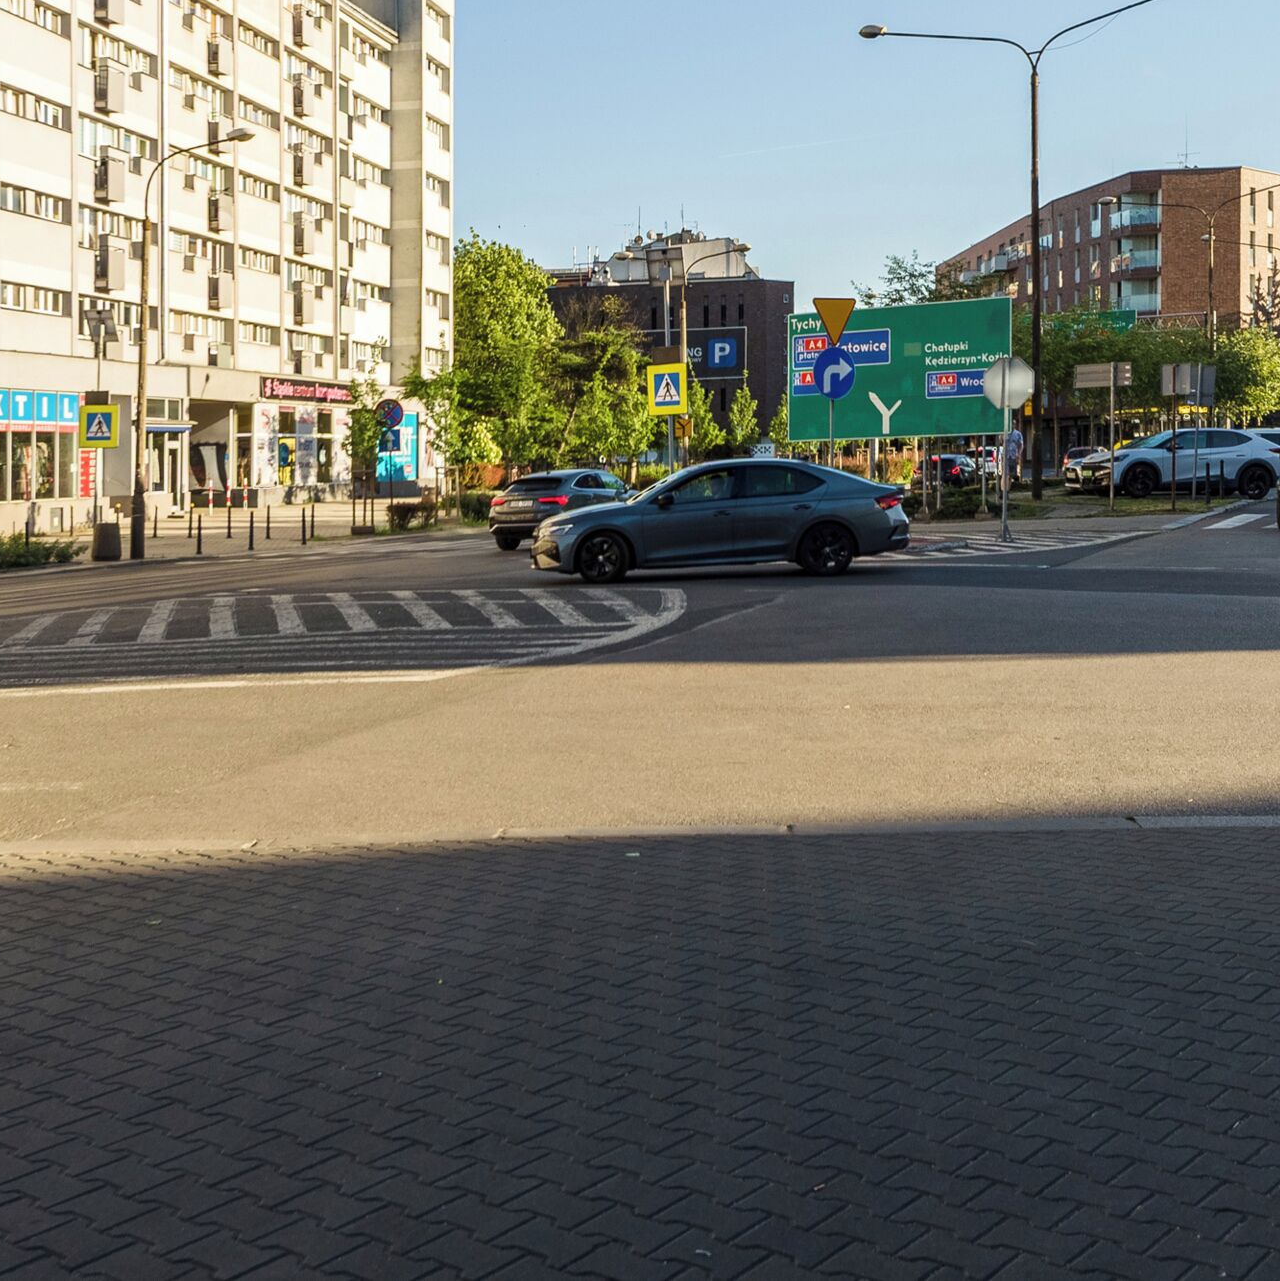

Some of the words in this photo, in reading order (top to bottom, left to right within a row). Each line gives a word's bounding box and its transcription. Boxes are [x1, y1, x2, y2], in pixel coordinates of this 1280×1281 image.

[791, 318, 821, 332] Tychy
[809, 340, 823, 350] A4
[835, 341, 887, 353] atowice
[924, 341, 969, 353] Chałupki
[799, 351, 819, 360] płatn
[941, 376, 953, 384] A4
[960, 377, 984, 386] Wroc
